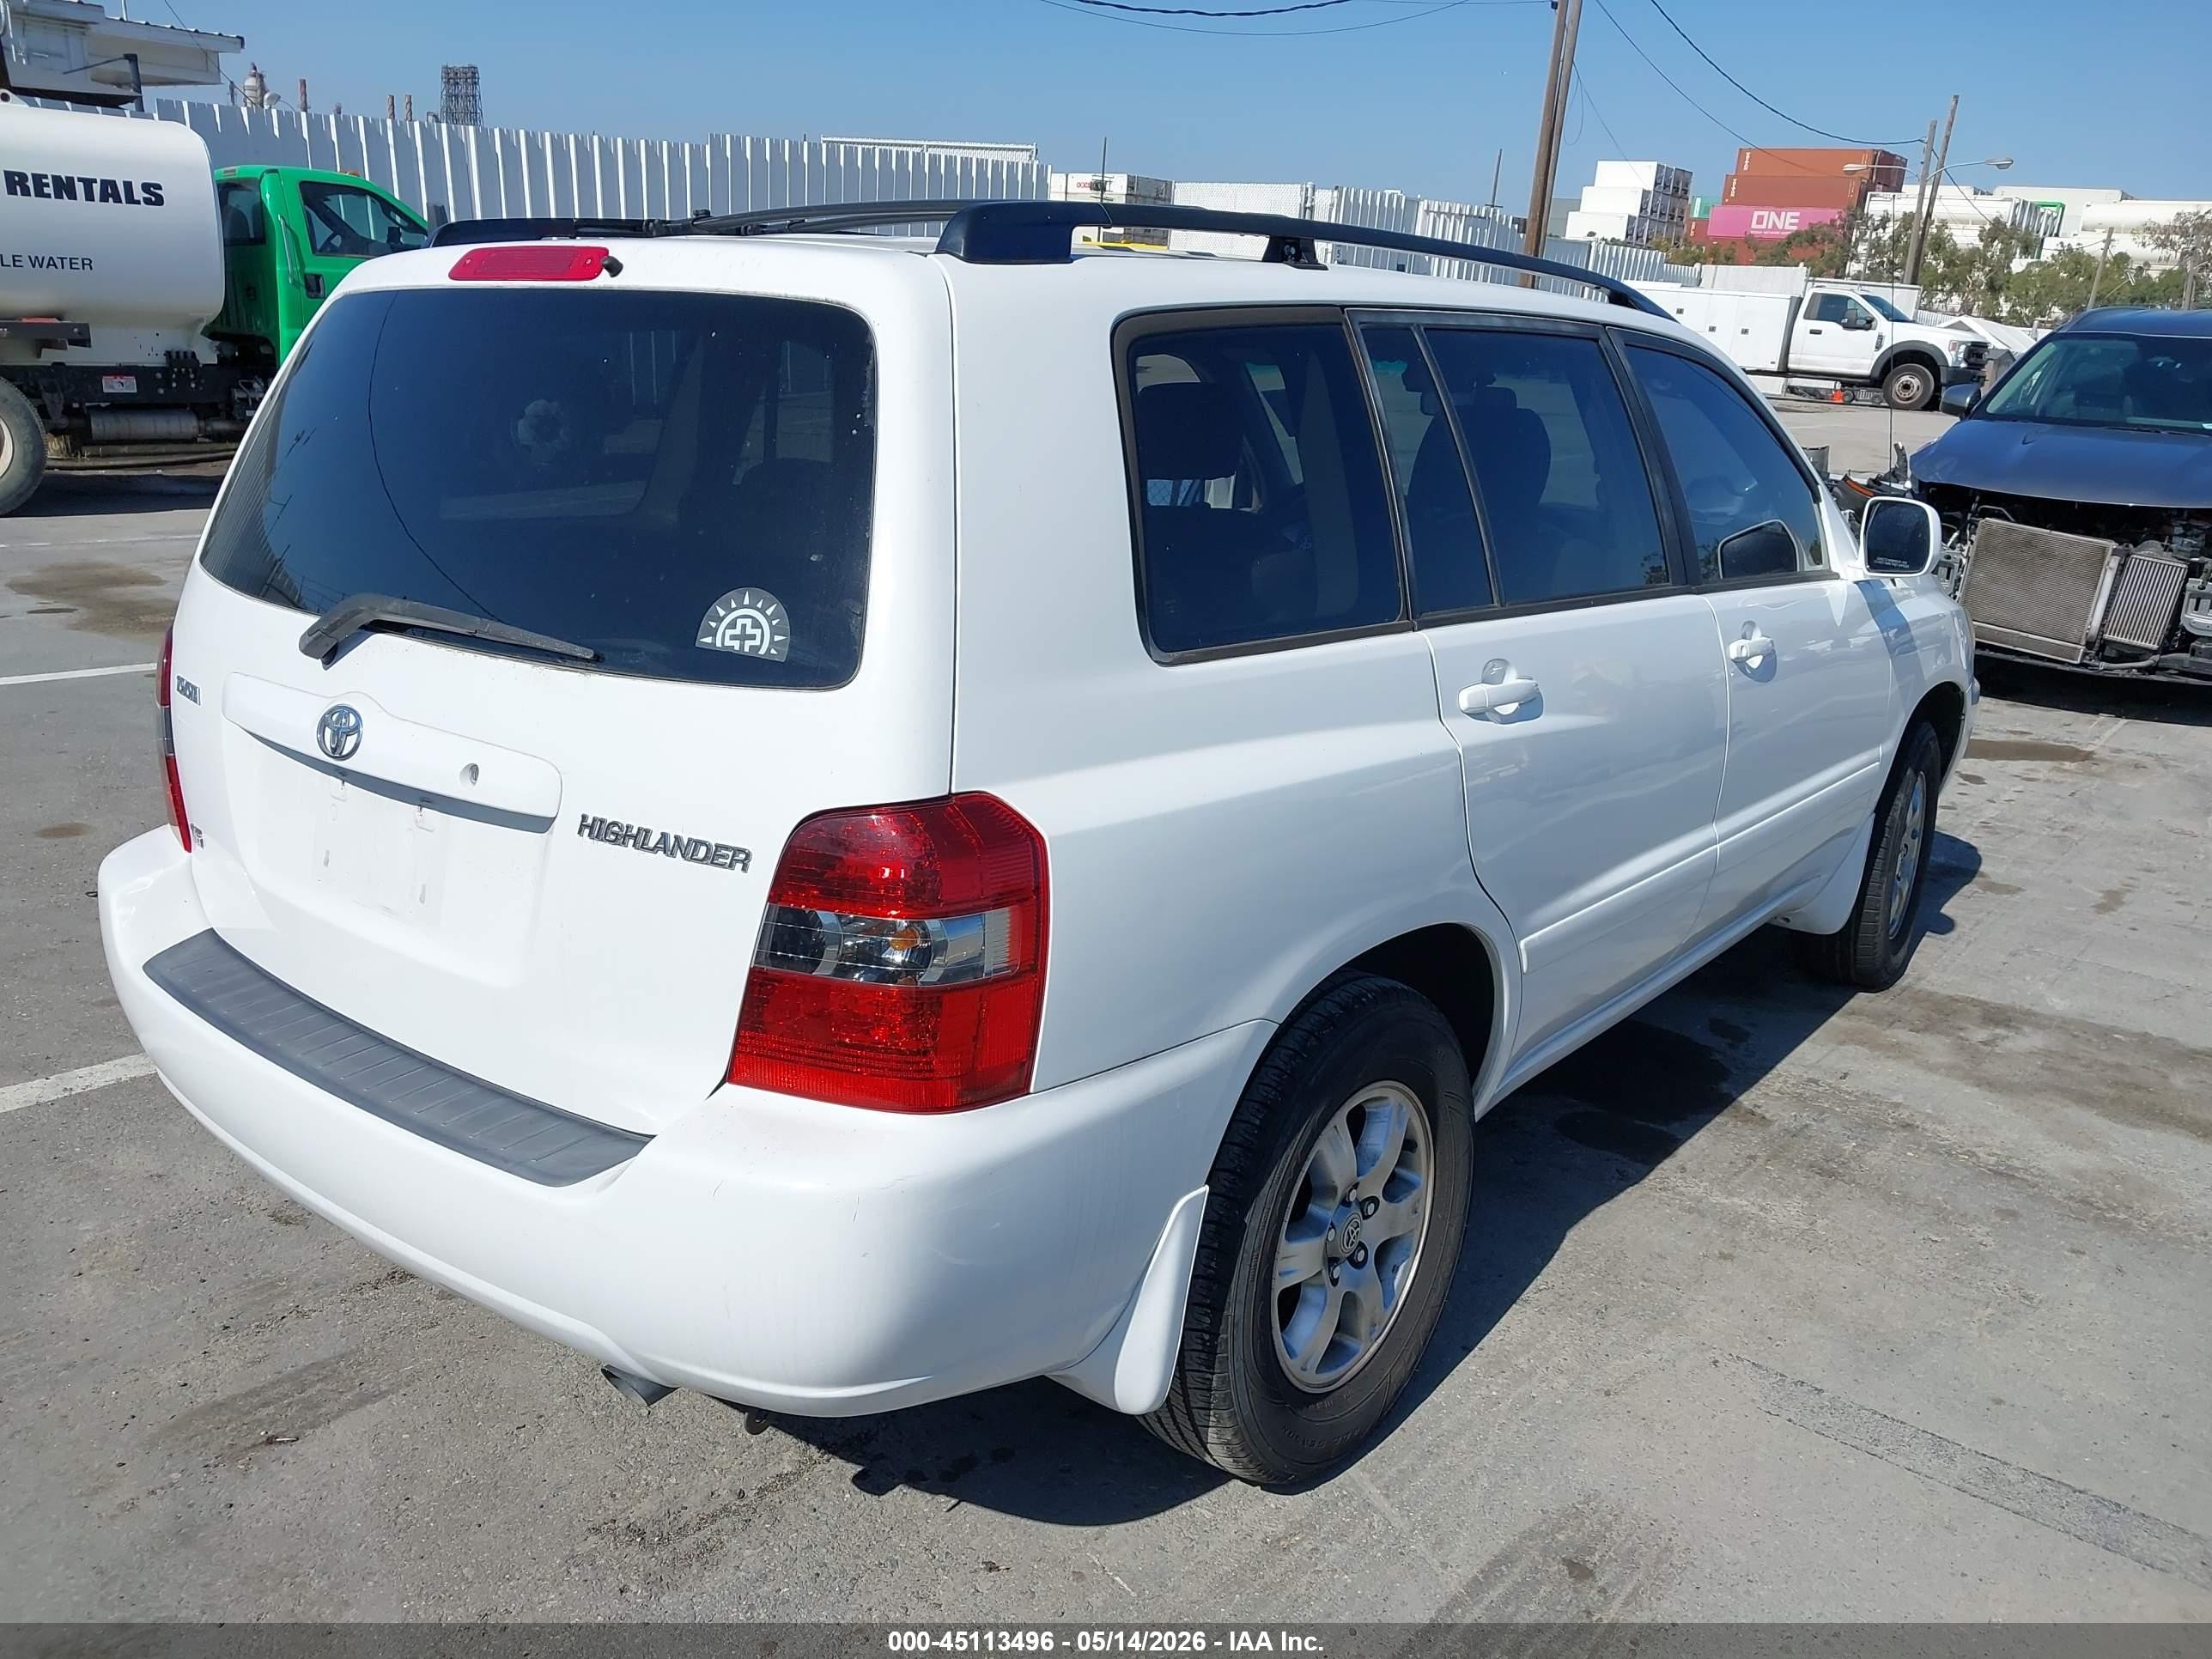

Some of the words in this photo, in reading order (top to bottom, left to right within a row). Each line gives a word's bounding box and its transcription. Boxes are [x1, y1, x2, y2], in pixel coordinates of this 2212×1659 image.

[3, 170, 164, 206] RENTALS
[1751, 211, 1800, 229] ONE
[28, 255, 93, 270] WATER
[577, 813, 752, 873] HIGHLANDER
